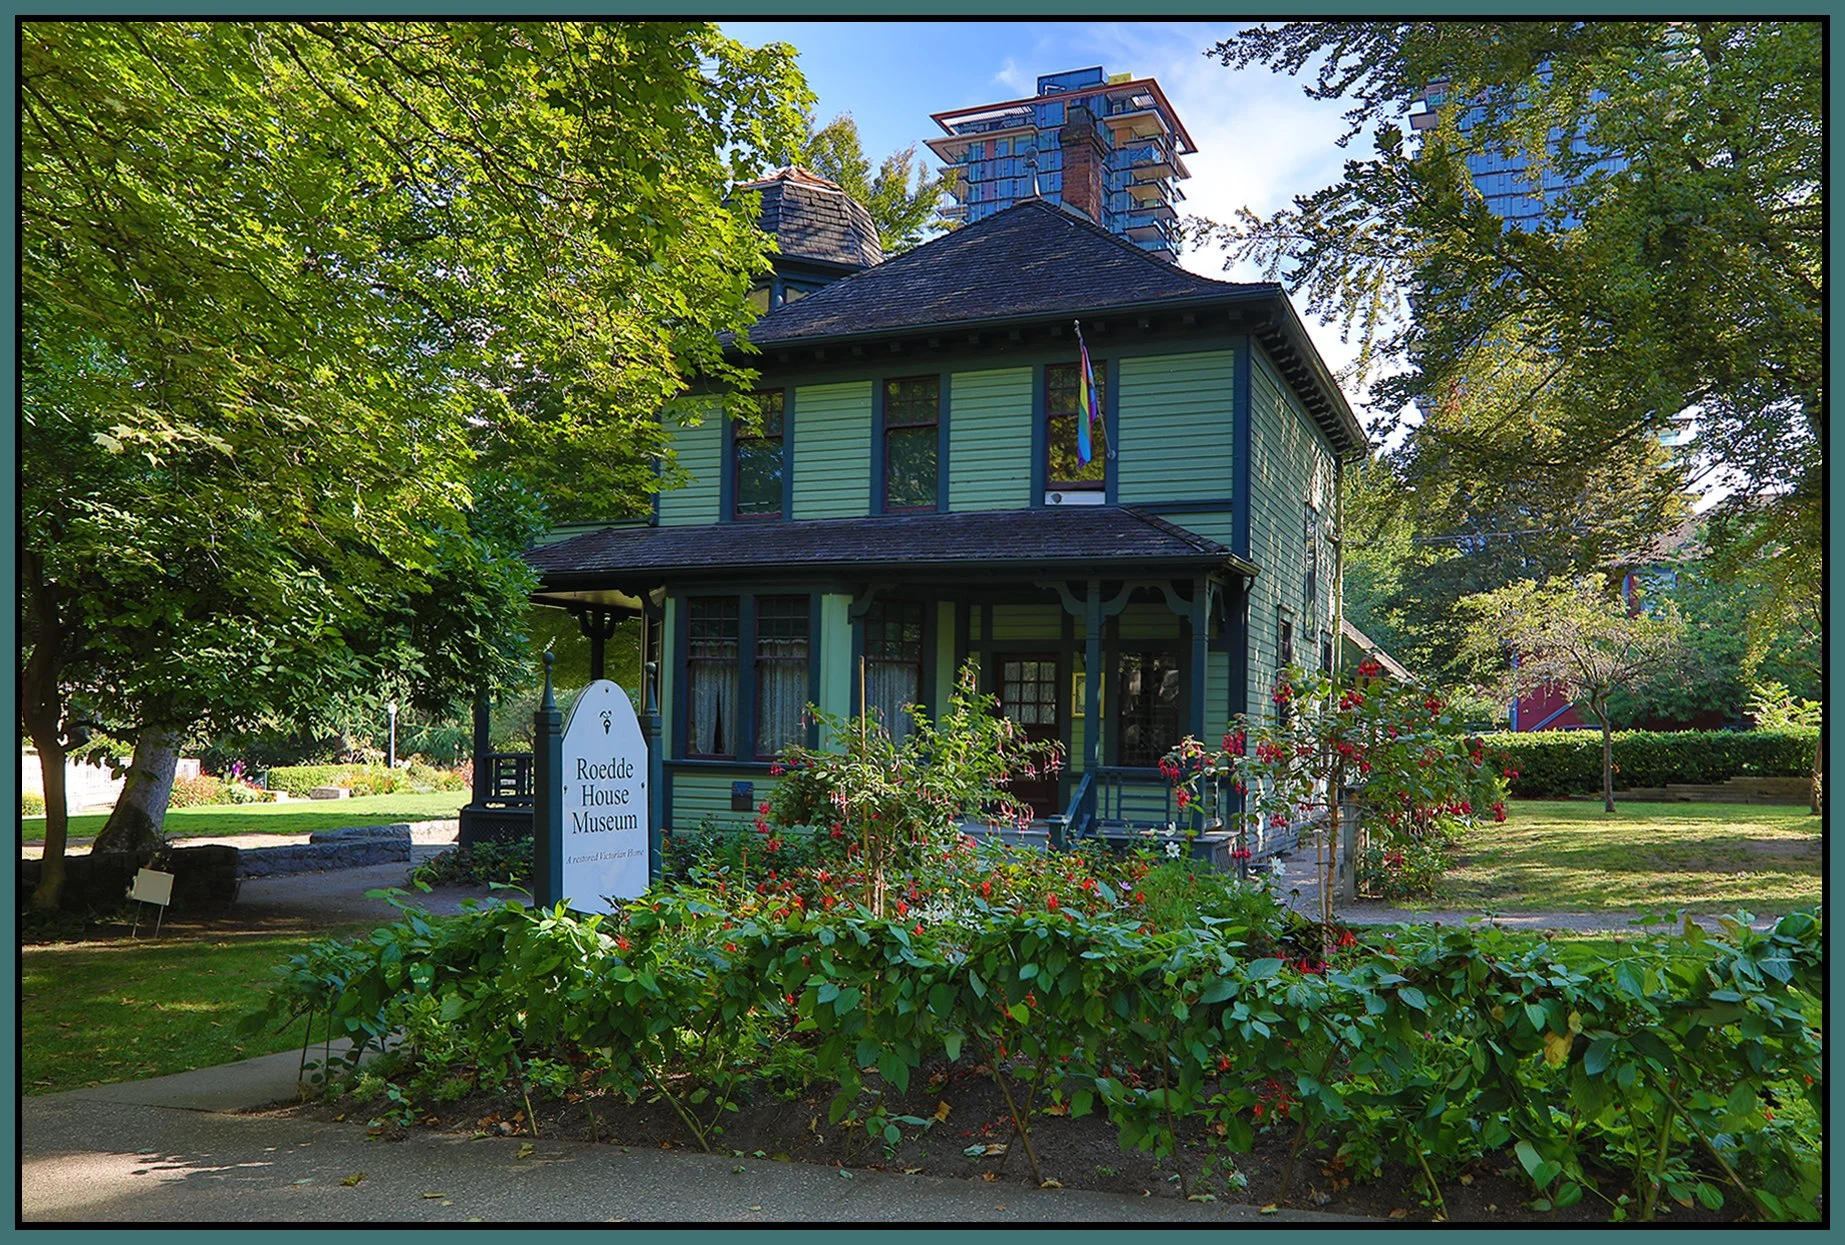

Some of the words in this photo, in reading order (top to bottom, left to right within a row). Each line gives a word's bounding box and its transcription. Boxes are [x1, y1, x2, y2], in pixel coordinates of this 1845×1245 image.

[576, 757, 634, 780] Roedde
[581, 784, 629, 807] House
[572, 811, 638, 834] Museum
